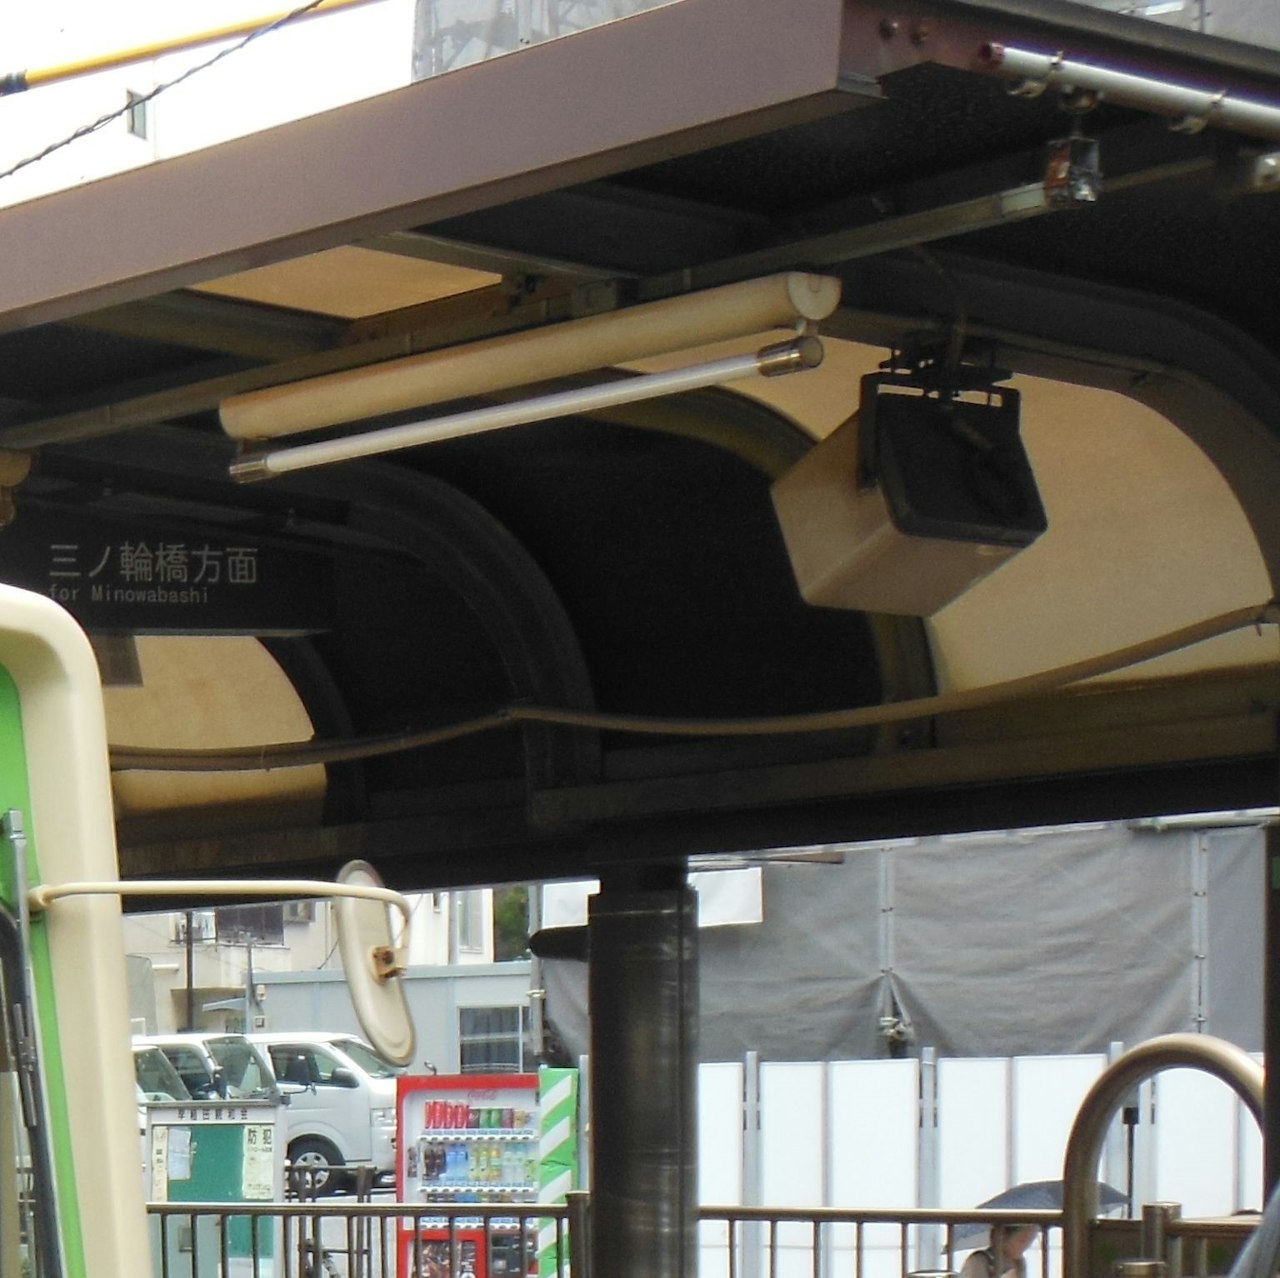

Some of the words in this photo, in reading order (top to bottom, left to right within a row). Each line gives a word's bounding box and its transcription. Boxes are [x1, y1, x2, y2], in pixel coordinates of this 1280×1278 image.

[49, 541, 258, 584] 三ノ輪橋方面
[48, 584, 81, 601] for
[91, 584, 209, 604] Minowabashi
